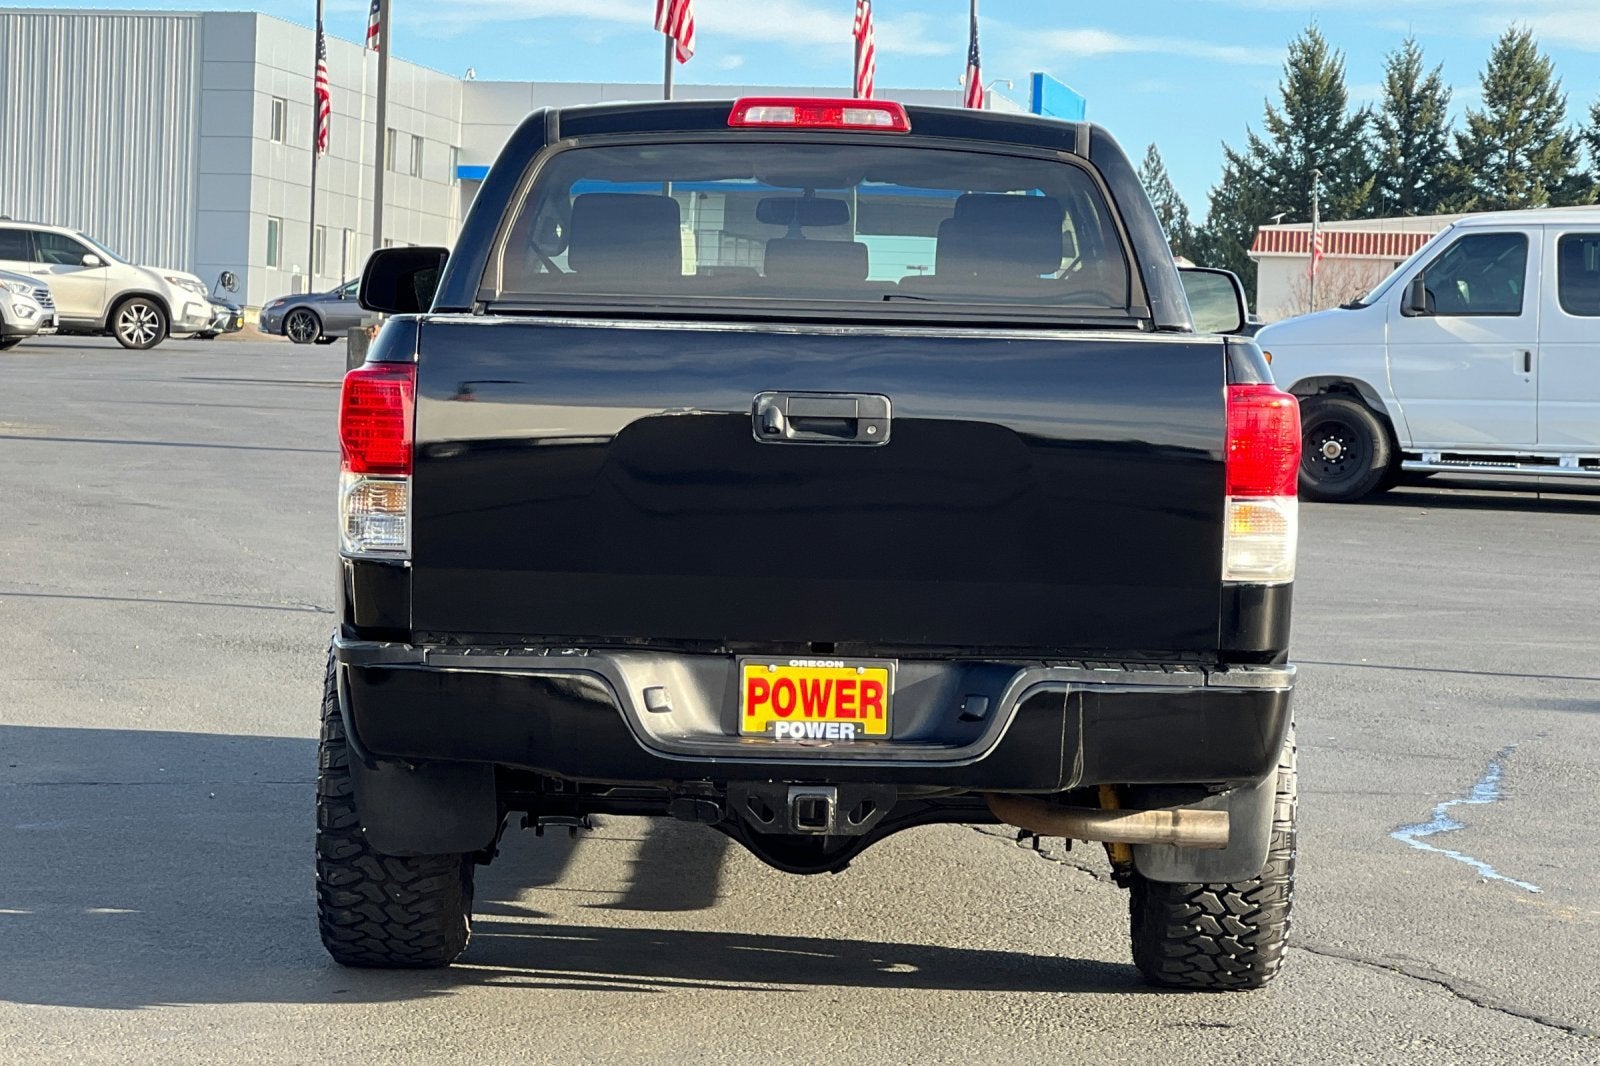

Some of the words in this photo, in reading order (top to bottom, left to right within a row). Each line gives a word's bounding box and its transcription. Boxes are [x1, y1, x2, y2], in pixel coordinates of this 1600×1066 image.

[789, 659, 844, 668] OREGON
[747, 677, 883, 719] POWER
[775, 721, 854, 739] POWER
